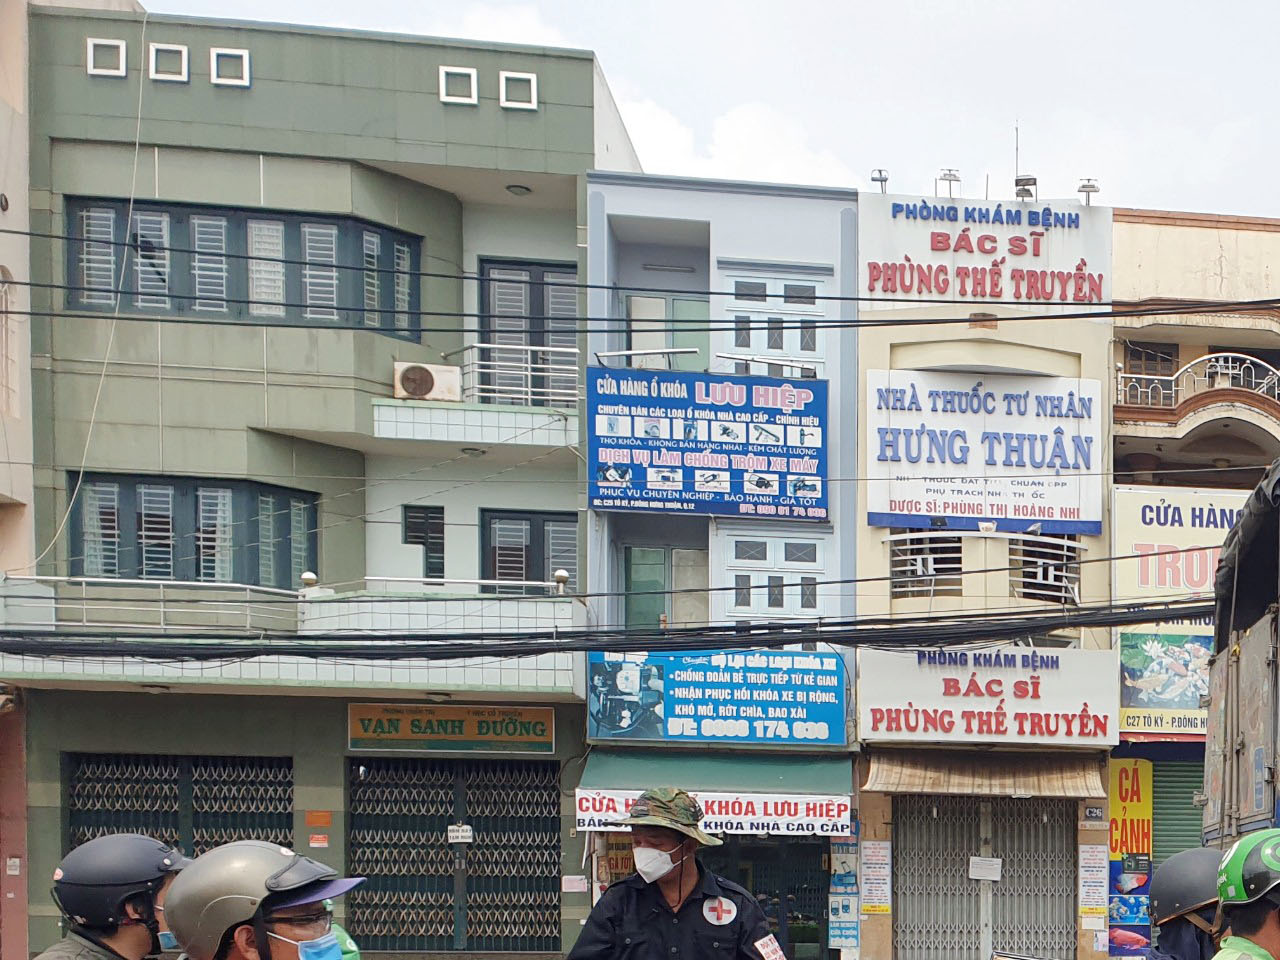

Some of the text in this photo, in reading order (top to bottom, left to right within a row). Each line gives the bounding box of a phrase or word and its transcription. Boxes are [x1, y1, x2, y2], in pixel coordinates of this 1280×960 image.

[892, 200, 1080, 232] PHÒNG KHÁM BỆNH
[931, 227, 1045, 257] BÁC SĨ
[867, 254, 1104, 302] PHÙNG THẾ TRUYỀN
[597, 373, 688, 399] CỬA HÀNG Ổ KHÓA
[695, 381, 814, 414] LƯU HIỆP
[876, 381, 1092, 419] NHÀ THUỐC TƯ NHÂN
[598, 404, 629, 415] CHUYÊN
[631, 405, 648, 416] BÁN
[649, 406, 666, 417] CÁC
[668, 408, 686, 420] LOẠI
[694, 408, 715, 420] KHÓA
[717, 410, 734, 421] NHÀ
[736, 412, 751, 422] CAO
[753, 410, 769, 423] CẤP
[776, 413, 799, 425] CHÍNH
[801, 415, 819, 427] HIỆU
[600, 436, 618, 445] THỢ
[619, 436, 642, 446] KHÓA
[648, 437, 677, 448] KHÔNG
[680, 438, 696, 449] BÁN
[697, 441, 720, 450] HÀNG
[748, 443, 764, 453] KÉM
[766, 444, 787, 454] CHẤT
[789, 446, 817, 456] LƯỢNG
[876, 422, 1094, 476] HƯNG THUẬN
[598, 447, 819, 474] DỊCH VỤ LÀM CHỐNG TRỘM XE MÁY
[600, 487, 625, 497] PHỤC
[627, 489, 640, 497] VỤ
[642, 489, 680, 499] CHUYÊN
[682, 490, 715, 501] NGHIỆP
[724, 492, 744, 502] BẢO
[746, 493, 773, 504] HÀNH
[799, 495, 817, 506] TỐT
[925, 488, 946, 496] PHỤ
[943, 500, 983, 515] PHÙNG
[989, 503, 1008, 518] THỊ
[1013, 503, 1054, 519] HOÀNG
[1060, 507, 1080, 519] NHI
[1141, 498, 1184, 527] CỬA
[917, 649, 1060, 672] PHÒNG KHÁM BỆNH
[674, 668, 704, 683] CHỐNG
[732, 669, 744, 684] BẺ
[746, 672, 768, 685] TRỰC
[770, 670, 789, 685] TIẾP
[804, 671, 815, 686] KẺ
[817, 675, 838, 686] GIAN
[942, 672, 1041, 699] BÁC SĨ
[674, 687, 839, 705] NHẬN PHỤC HỒI KHÓA XE BỊ RỘNG,
[674, 701, 807, 719] KHÓ MỞ, RỚT CHÌA, BAO XÀI
[870, 699, 1109, 737] PHÙNG THẾ TRUYỀN
[1126, 715, 1140, 727] C27
[1171, 714, 1198, 729] P.ĐÔNG
[359, 718, 401, 738] VẠN
[410, 718, 465, 736] SANH
[753, 720, 790, 739] 174
[1118, 759, 1142, 803] CÁ
[578, 791, 618, 813] CỬA
[704, 796, 756, 816] KHÓA
[763, 800, 799, 817] LƯU
[805, 799, 849, 822] HIỆP
[1085, 807, 1102, 817] C26
[703, 819, 744, 831] KHÓA
[749, 819, 781, 831] NHÀ
[786, 822, 815, 832] CAO
[820, 820, 850, 833] CẤP
[1109, 805, 1151, 854] CẢNH
